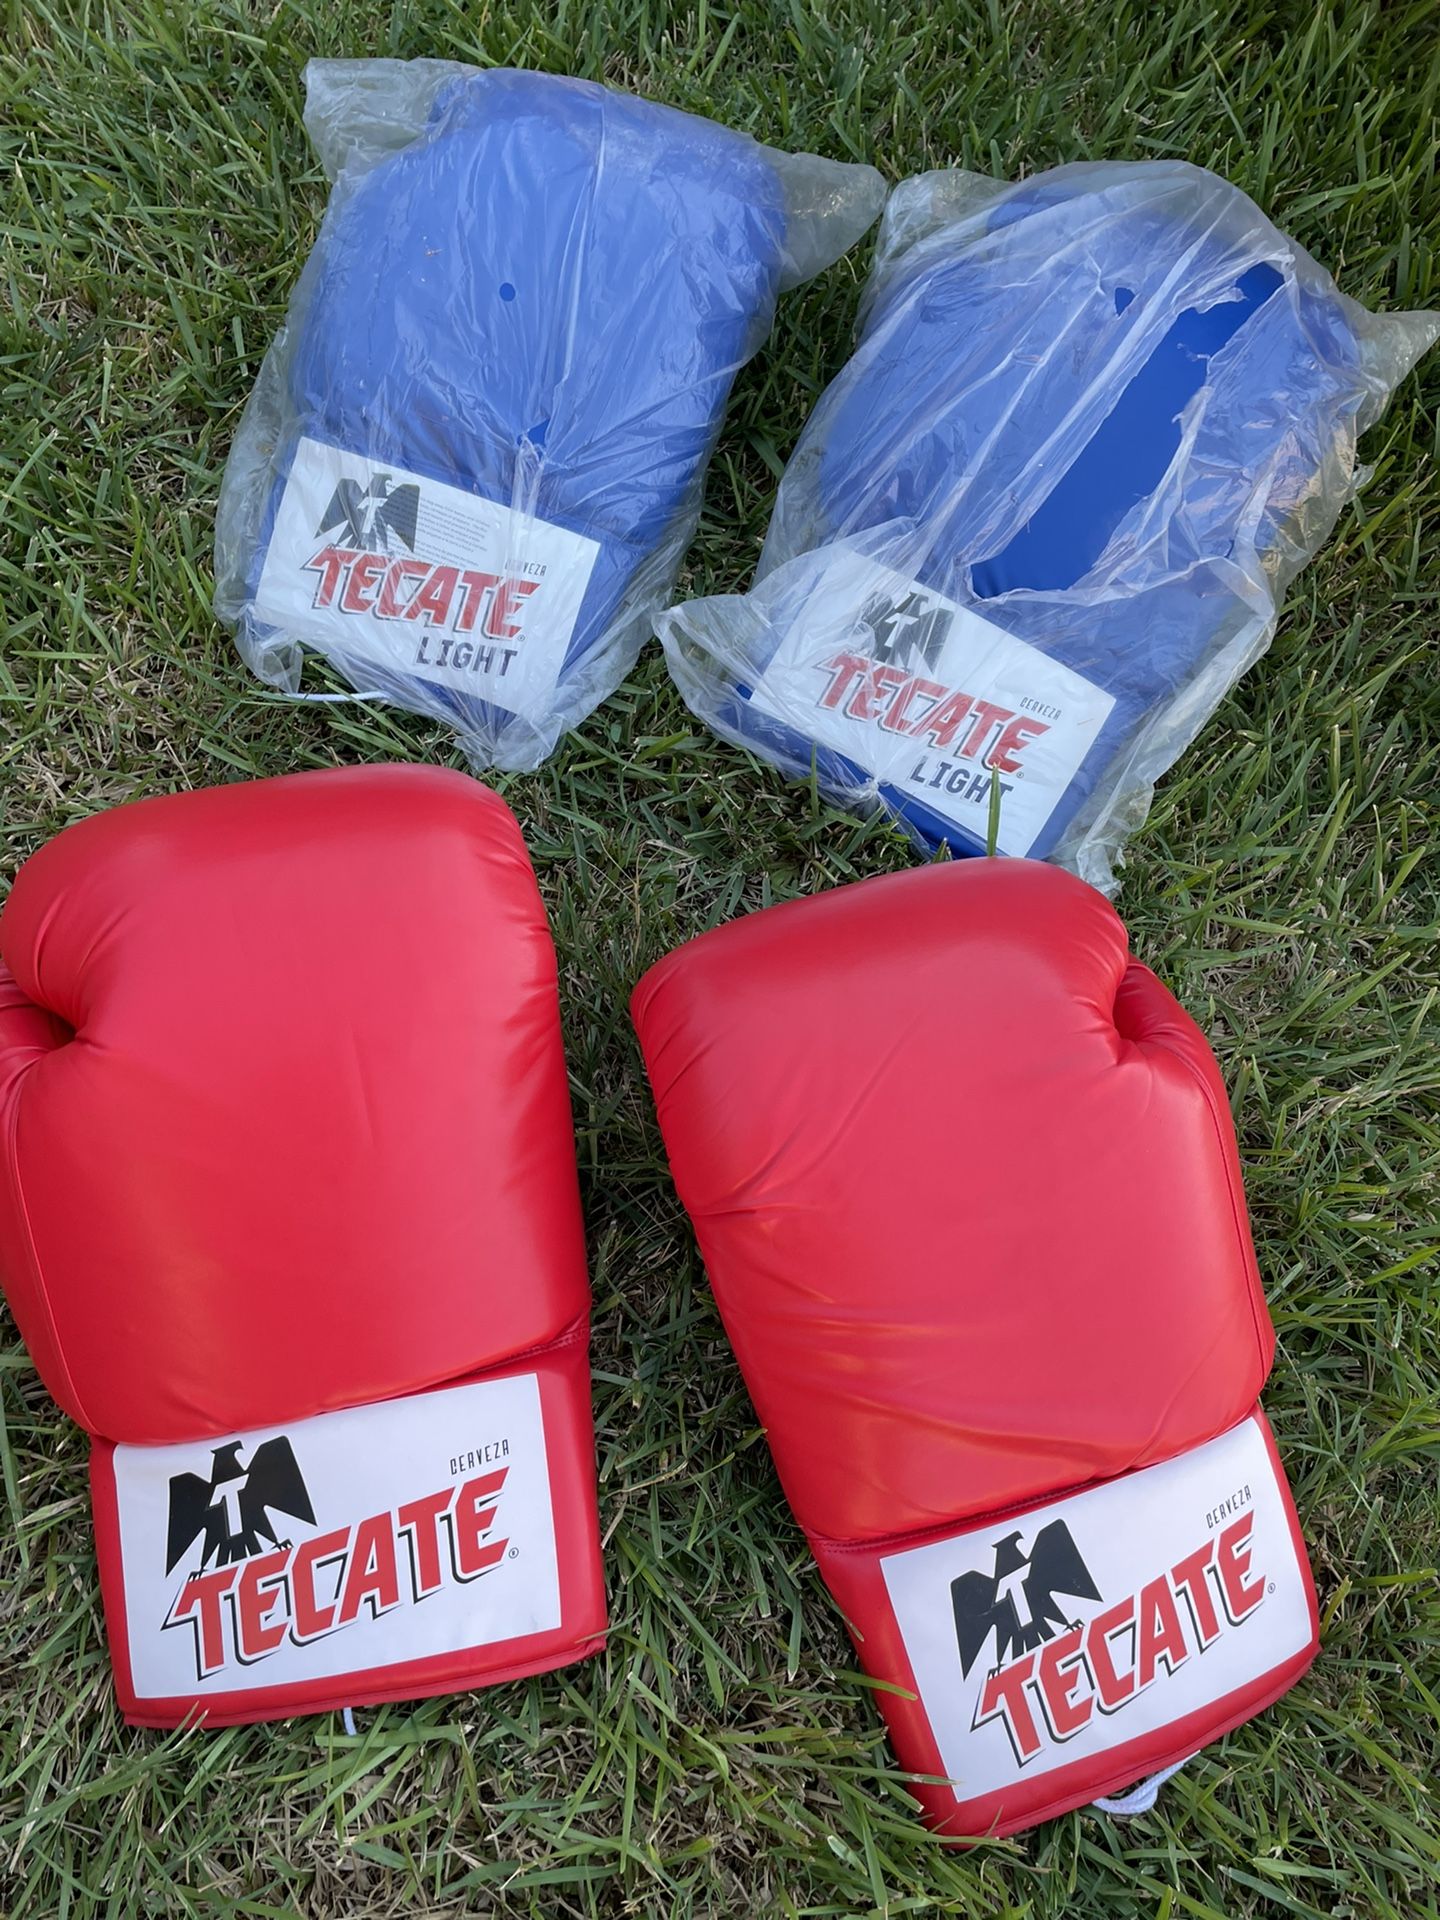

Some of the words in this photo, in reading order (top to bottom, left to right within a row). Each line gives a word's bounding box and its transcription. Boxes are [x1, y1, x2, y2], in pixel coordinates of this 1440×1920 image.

[300, 546, 541, 640] TECATE
[416, 636, 518, 676] LIGHT
[813, 653, 1051, 775] TECATE
[1020, 697, 1062, 720] CERVEZA
[449, 1439, 510, 1475] CERVEZA
[1207, 1484, 1252, 1529] CERVEZA
[160, 1466, 510, 1681] TECATE
[970, 1509, 1269, 1768] TECATE
